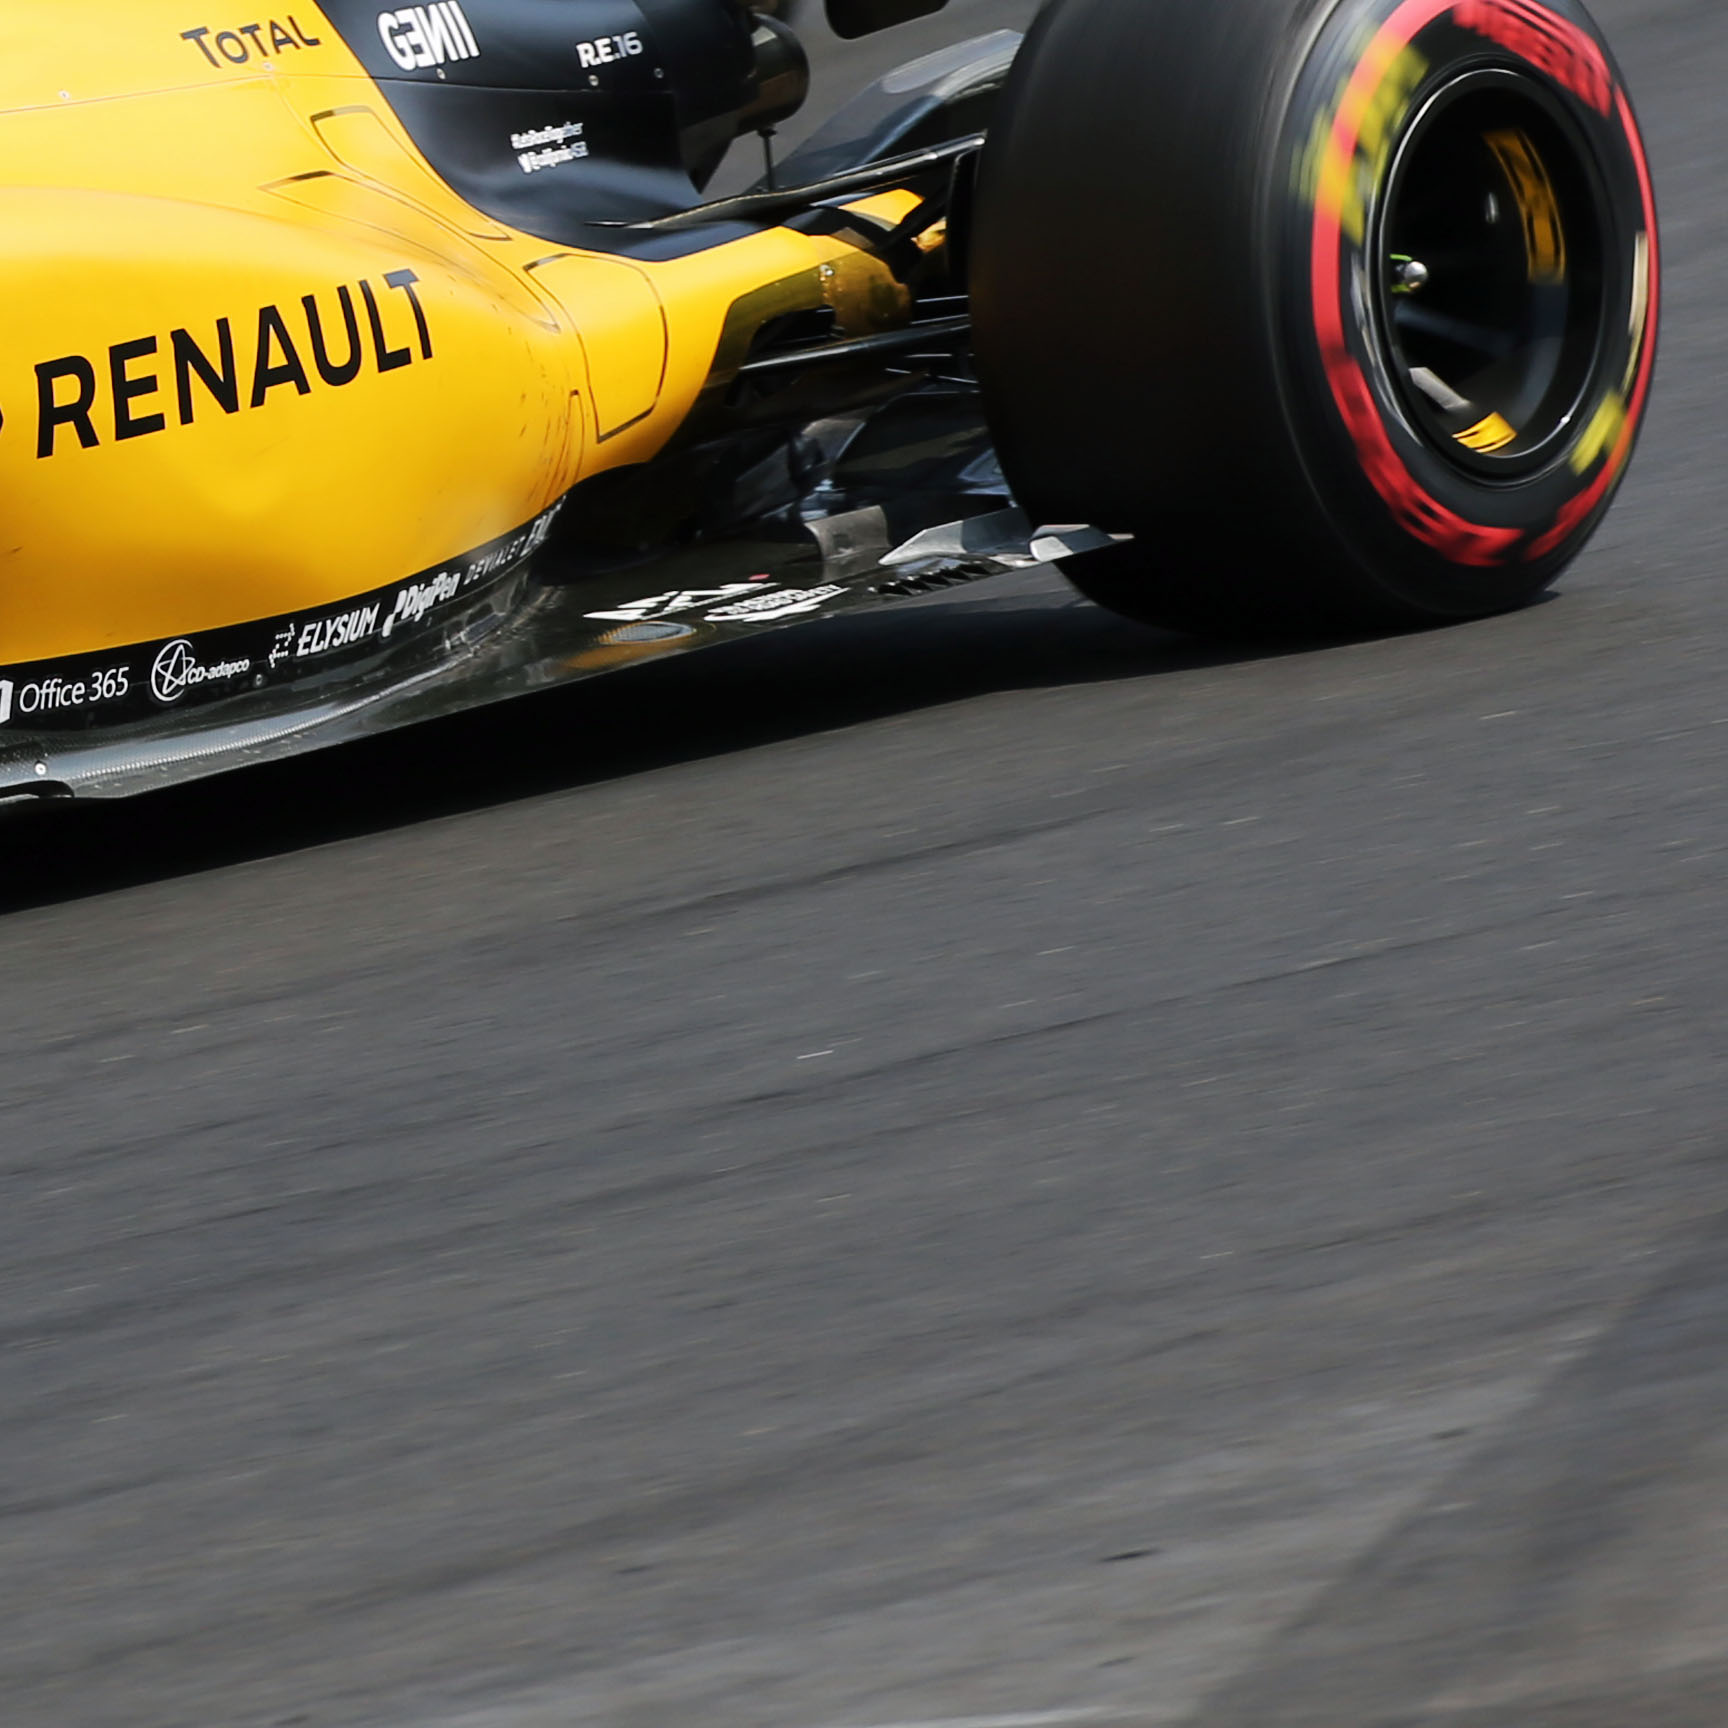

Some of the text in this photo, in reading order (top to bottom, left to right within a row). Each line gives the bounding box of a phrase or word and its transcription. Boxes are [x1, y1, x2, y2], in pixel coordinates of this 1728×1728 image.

[179, 15, 322, 68] TOTAL
[575, 32, 643, 68] R.E.16
[34, 268, 435, 459] RENAULT
[296, 602, 381, 657] ELYSIUM
[19, 666, 130, 713] Office 365
